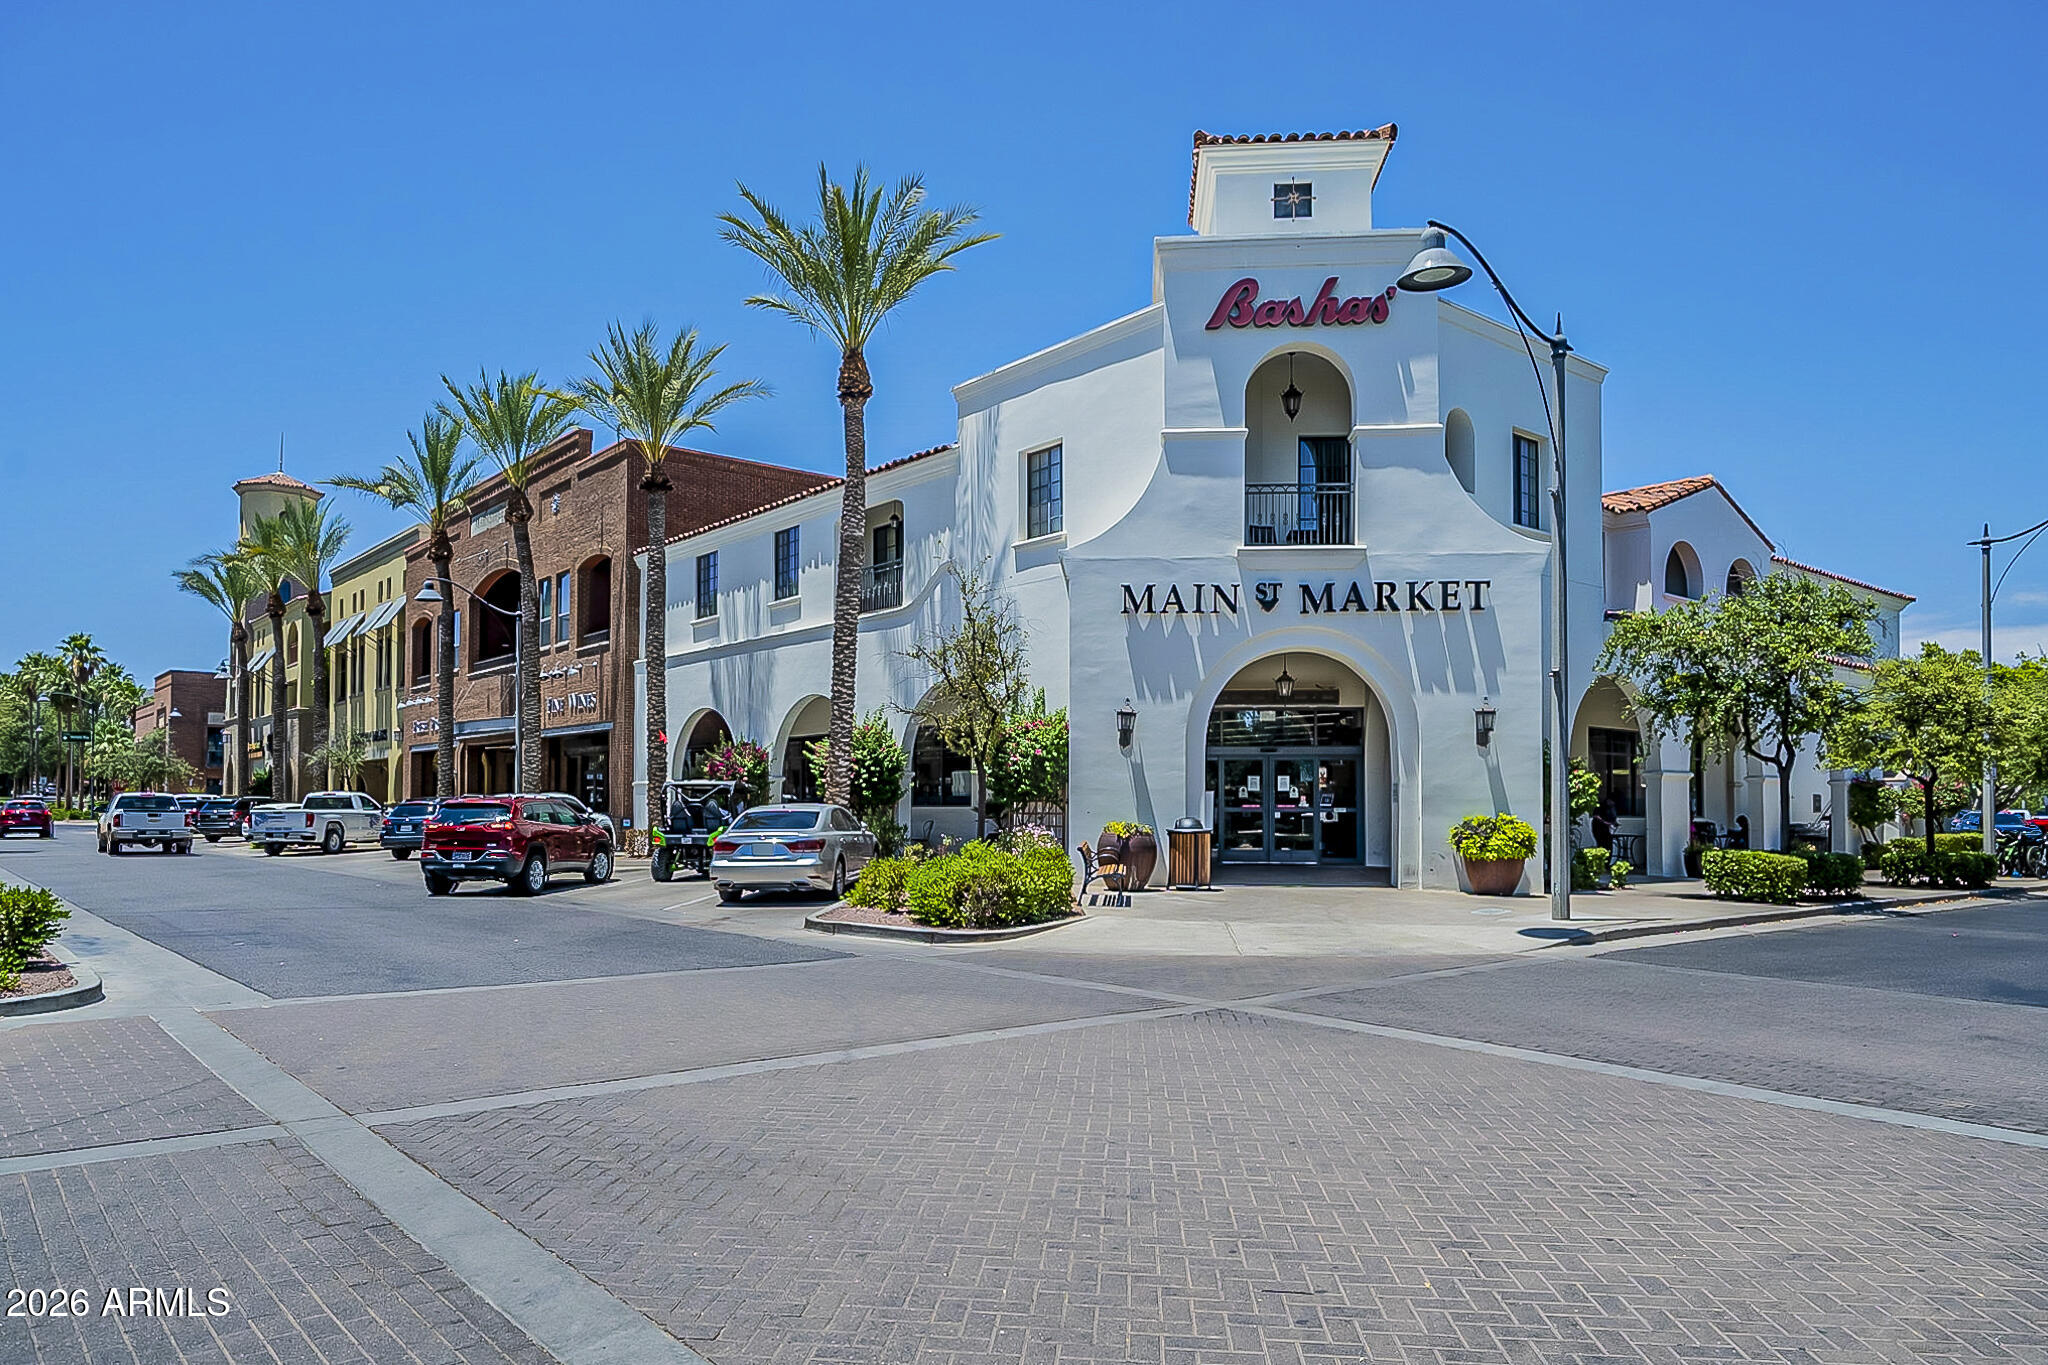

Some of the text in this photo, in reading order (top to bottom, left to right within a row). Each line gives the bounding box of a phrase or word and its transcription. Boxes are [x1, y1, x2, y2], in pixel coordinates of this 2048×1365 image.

[1205, 276, 1398, 330] Bashas'
[1120, 580, 1491, 614] MAIN ST MARKET
